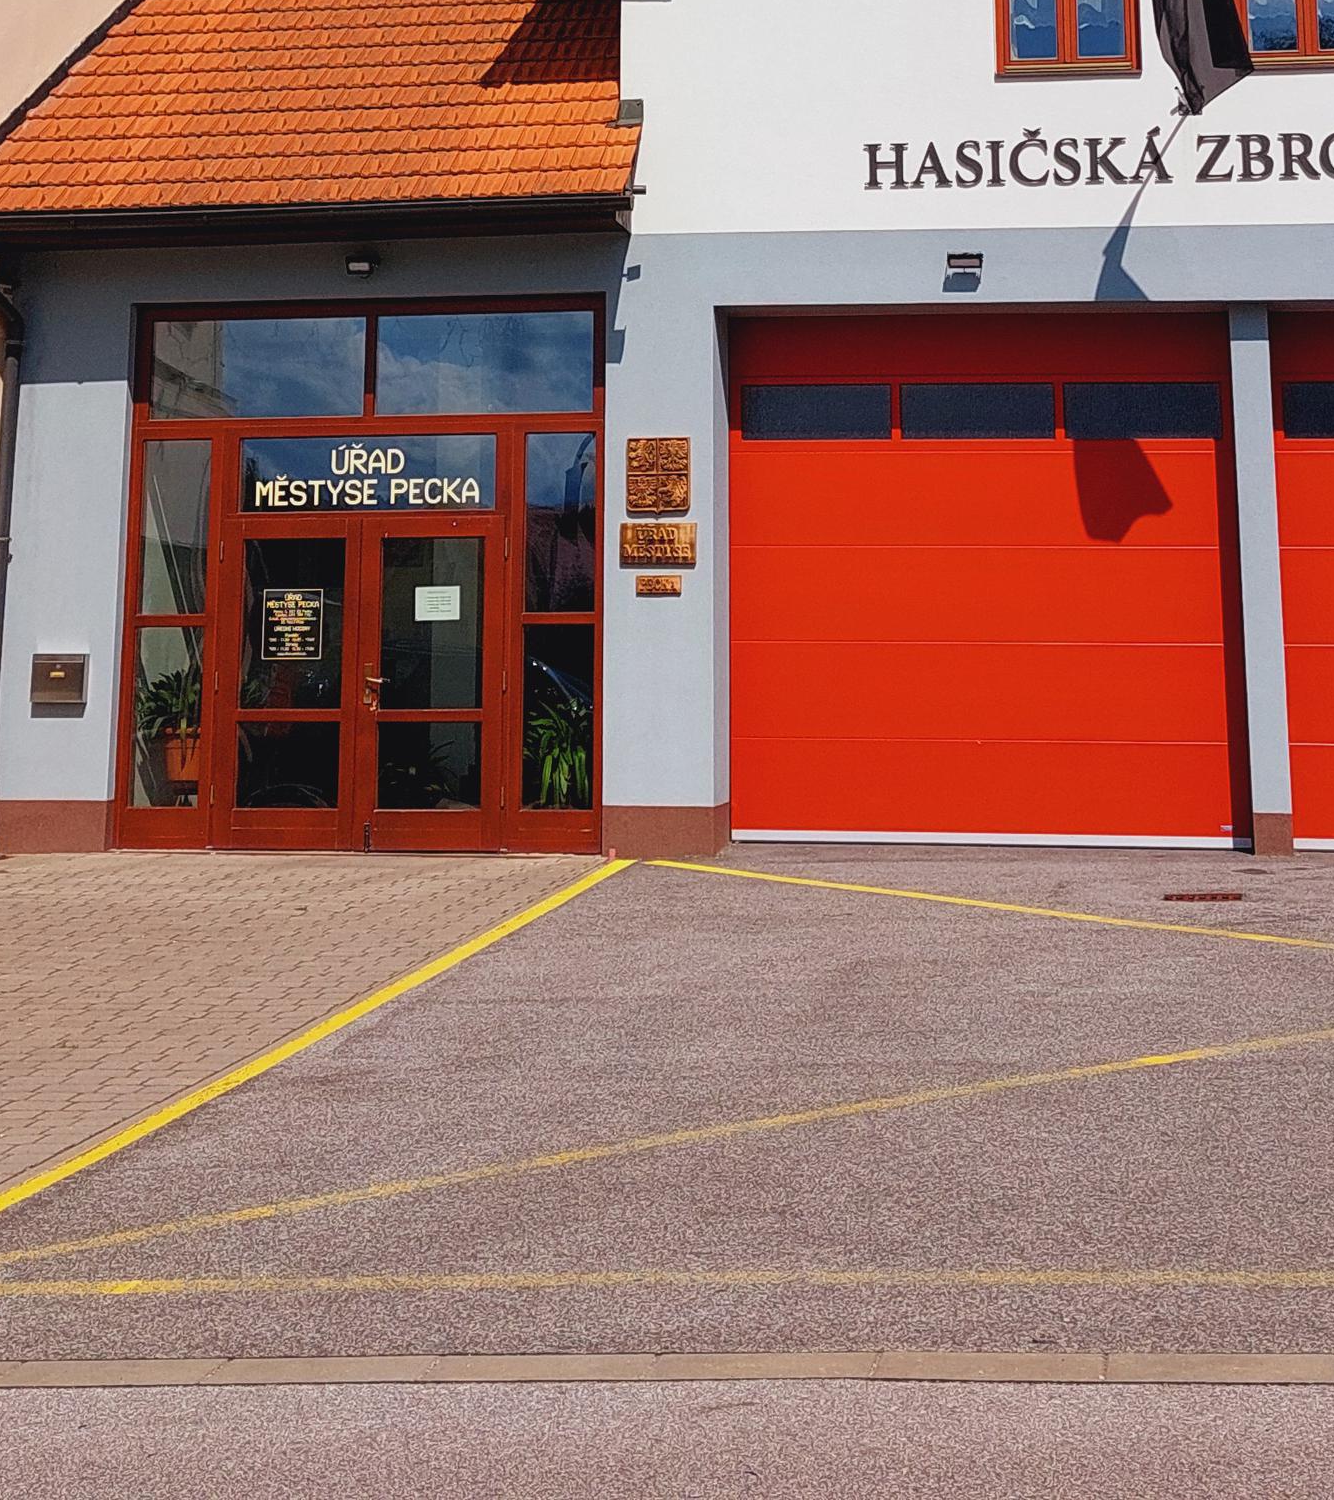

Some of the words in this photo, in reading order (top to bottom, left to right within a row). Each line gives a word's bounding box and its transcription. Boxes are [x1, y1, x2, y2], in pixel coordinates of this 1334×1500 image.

[864, 126, 1174, 191] HASIČSKÁ
[330, 442, 405, 475] ÚŘAD
[254, 473, 379, 507] MĚSTYSE
[389, 477, 481, 505] PECKA
